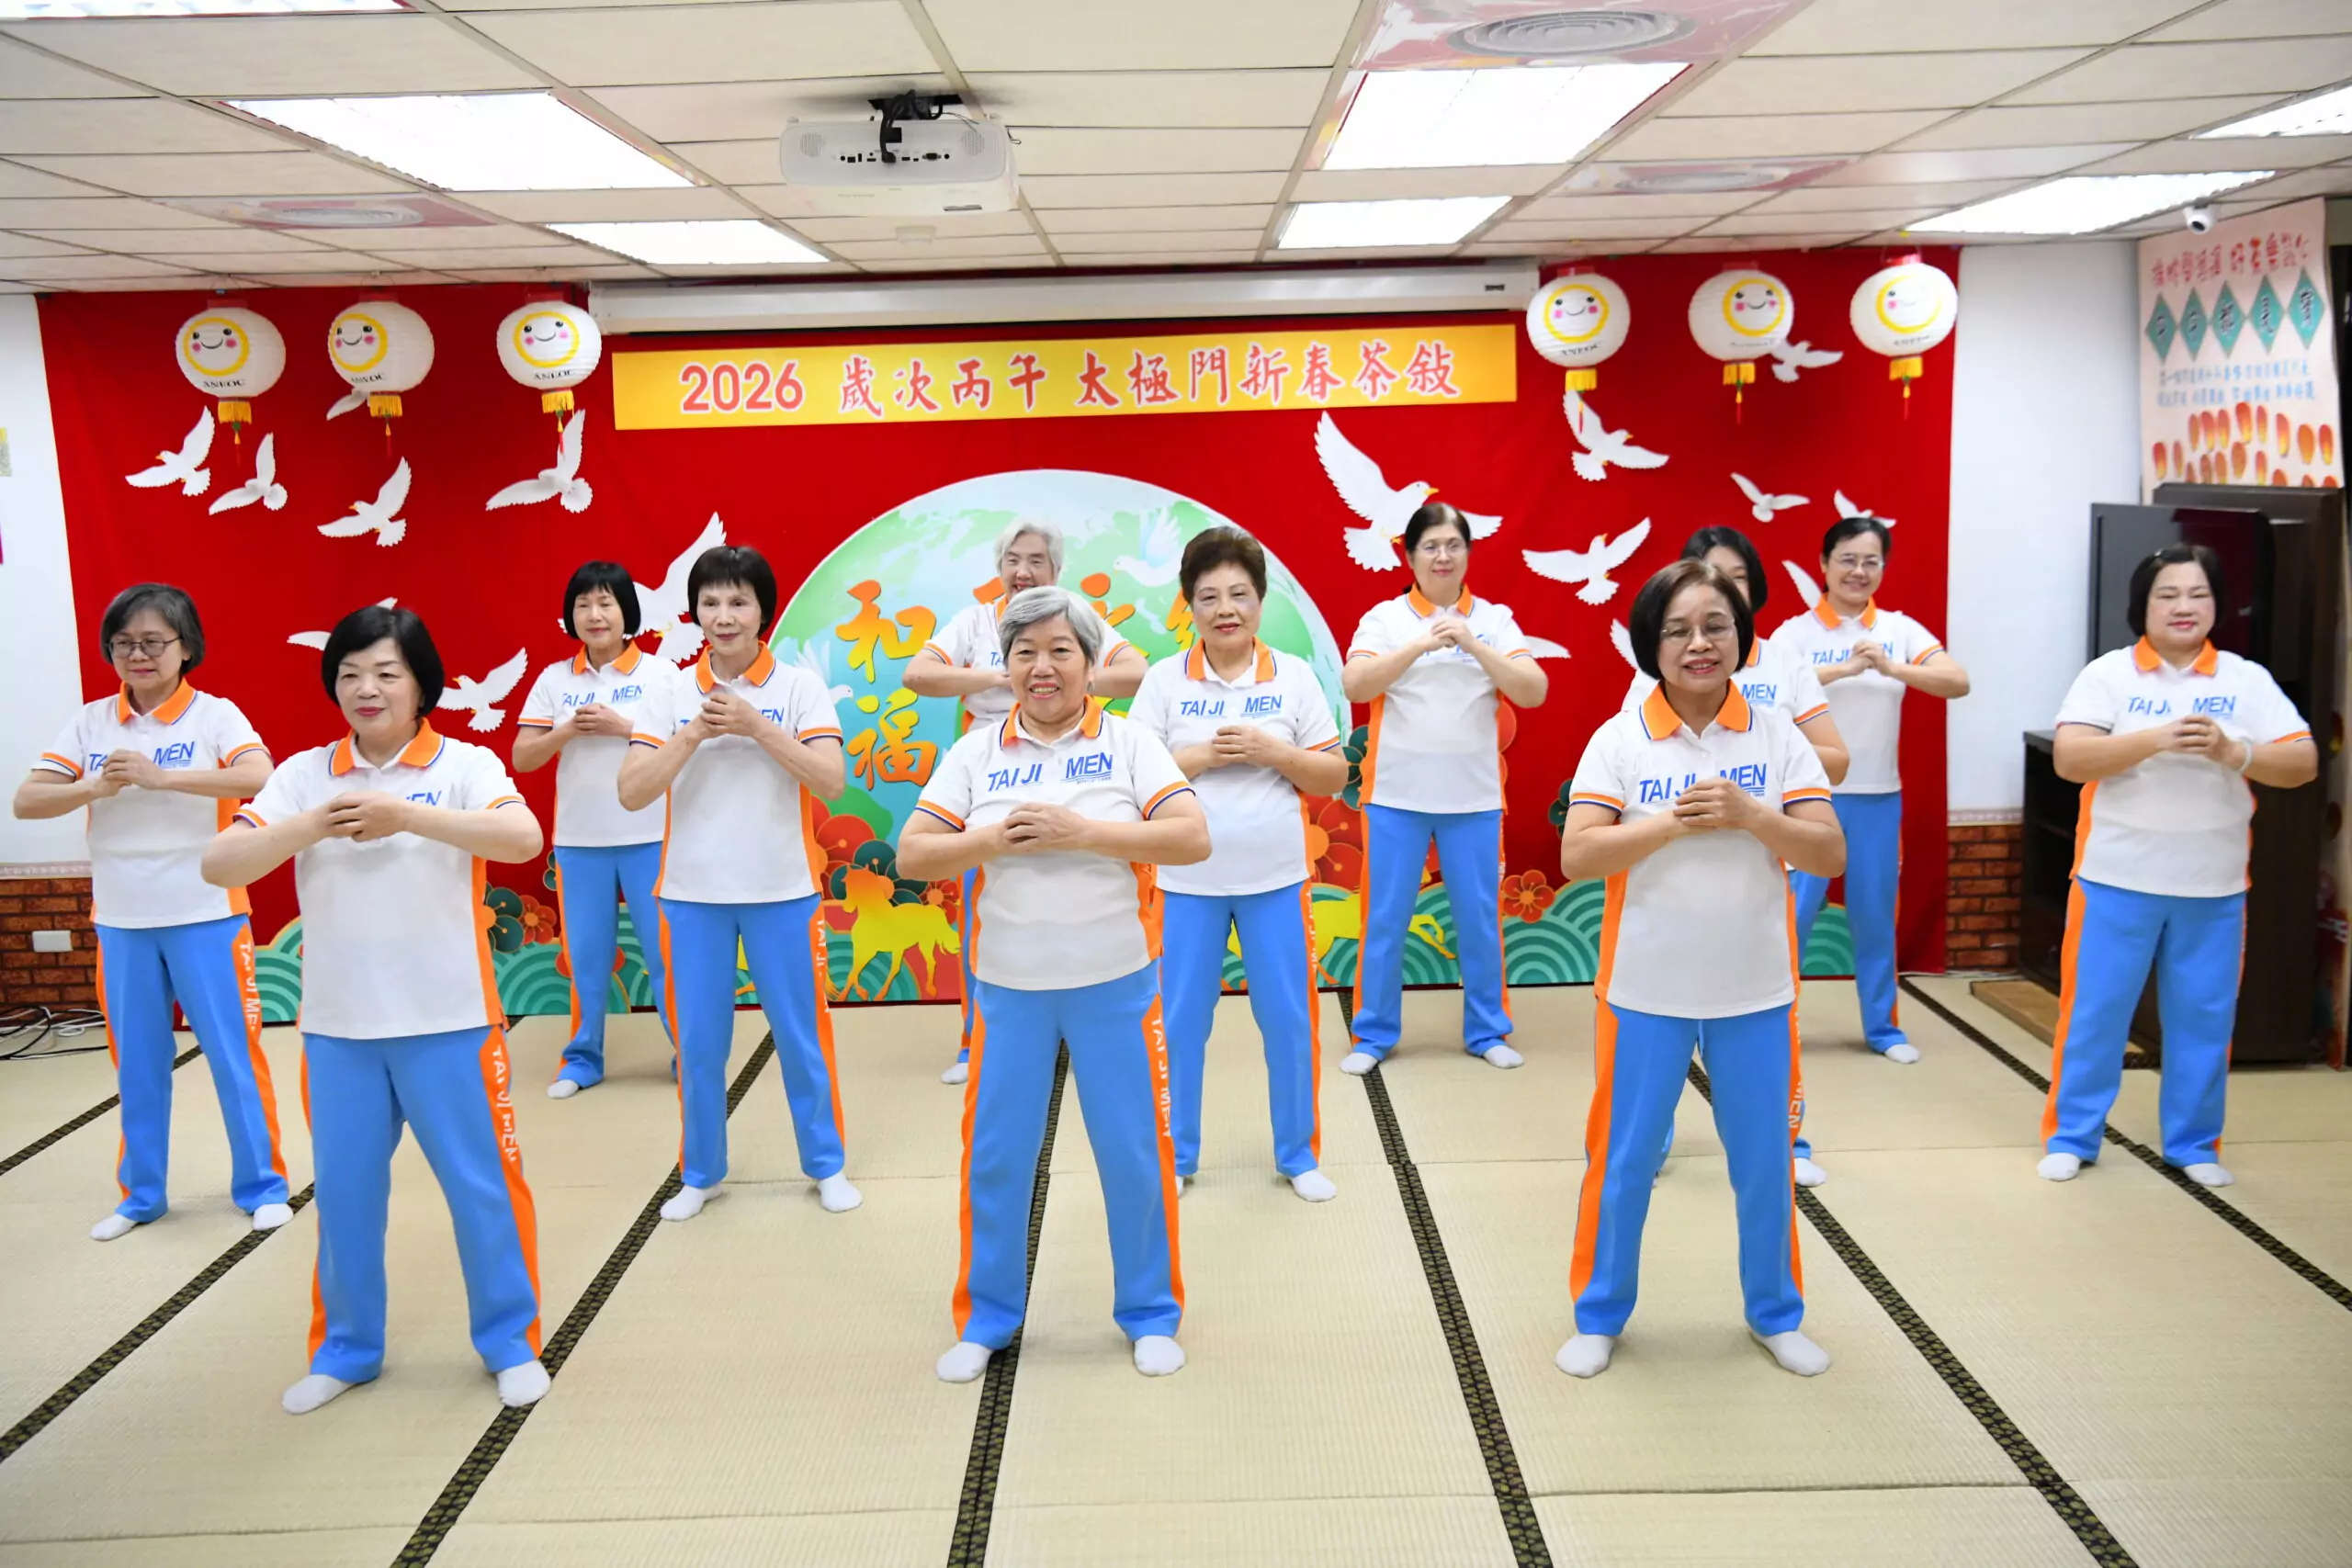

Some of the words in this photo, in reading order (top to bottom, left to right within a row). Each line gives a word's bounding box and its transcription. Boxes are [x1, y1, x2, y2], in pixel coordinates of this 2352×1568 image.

[680, 362, 805, 413] 2026
[840, 354, 1047, 419] 歲次丙午
[1741, 683, 1777, 700] MEN
[2192, 695, 2236, 713] MEN
[1180, 700, 1206, 716] TAI
[1244, 694, 1283, 713] MEN
[153, 740, 195, 766] MEN
[988, 768, 1020, 792] TAI
[1021, 763, 1043, 784] JI
[1065, 752, 1114, 779] MEN
[1639, 777, 1672, 804] TAI
[1719, 763, 1767, 787] MEN
